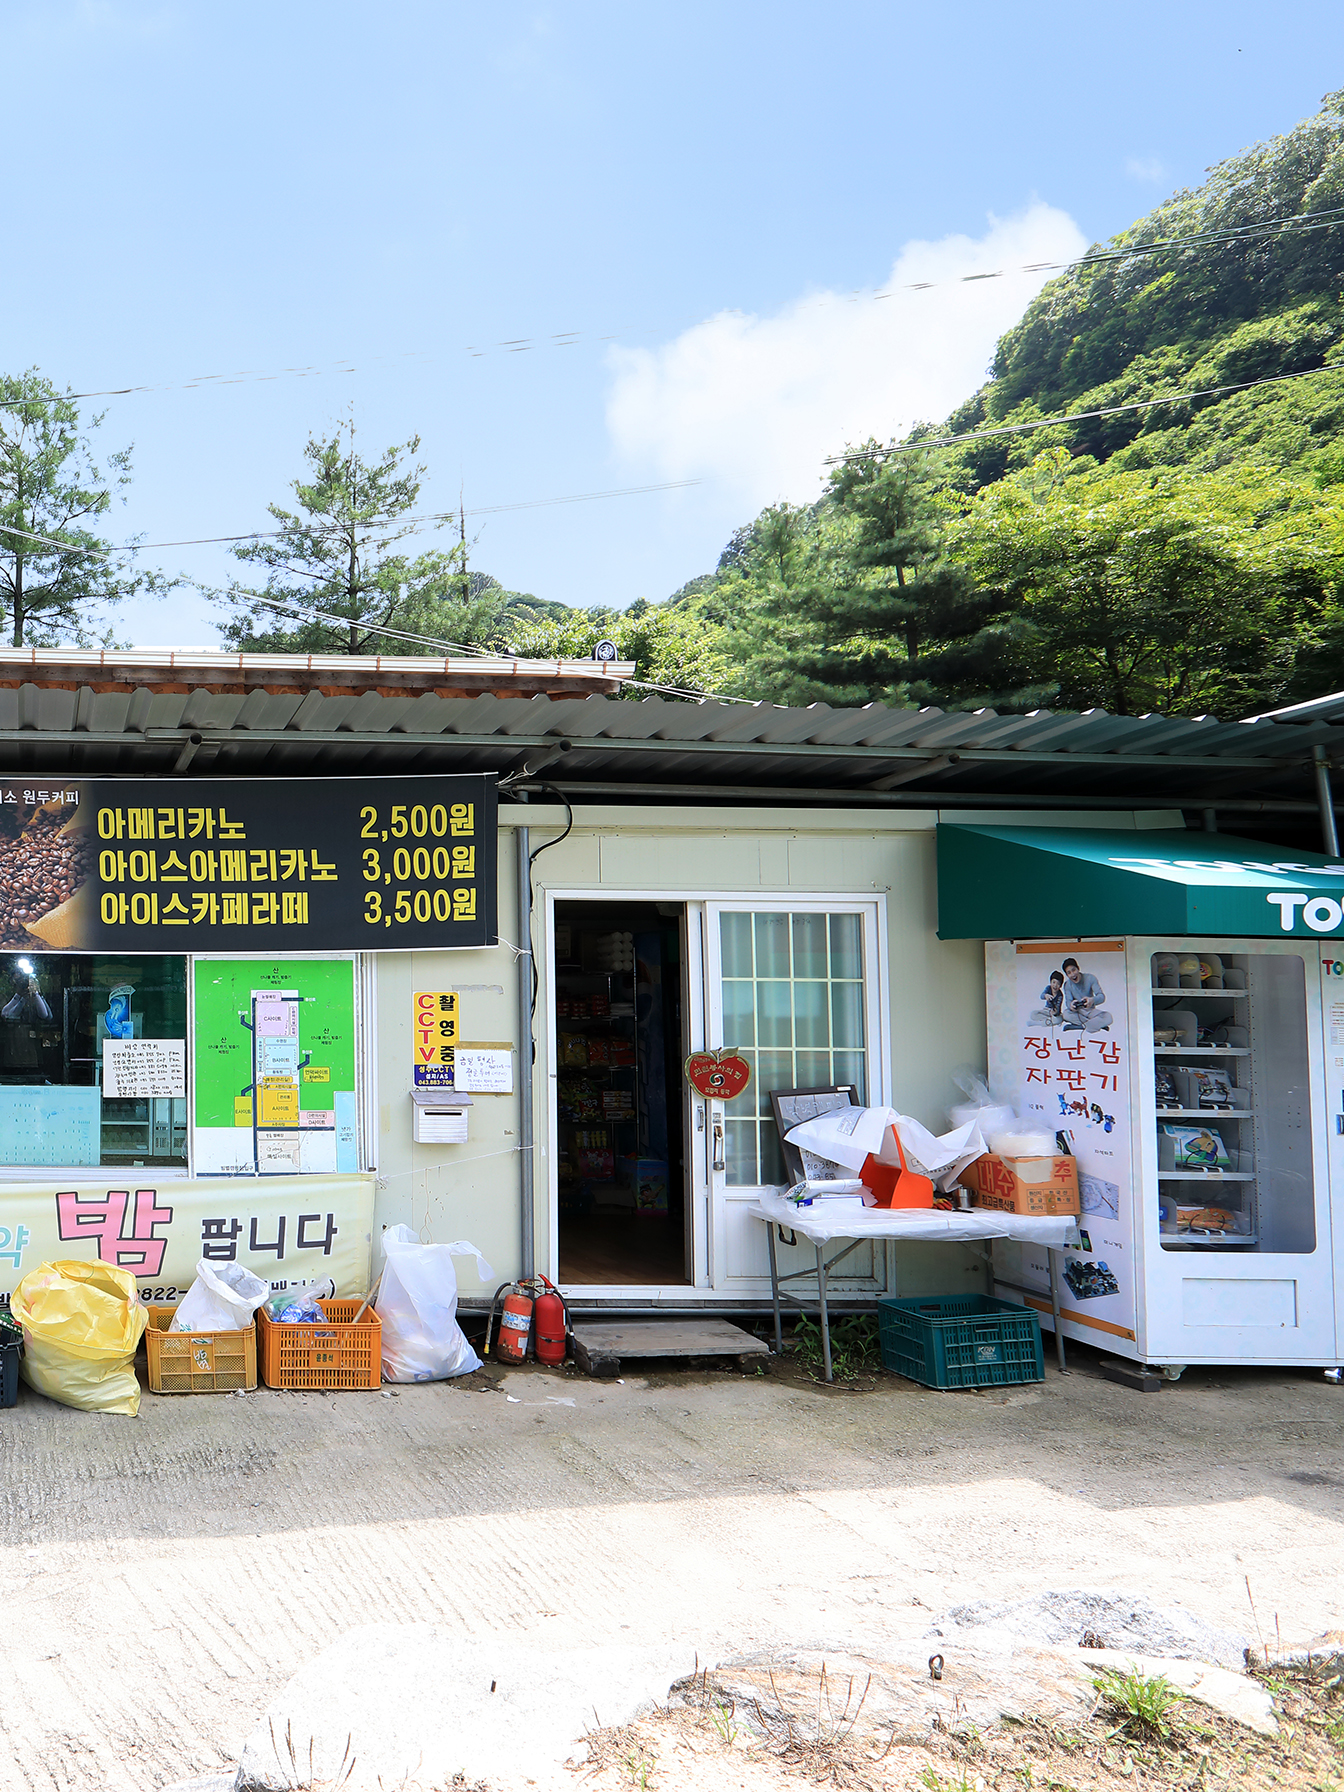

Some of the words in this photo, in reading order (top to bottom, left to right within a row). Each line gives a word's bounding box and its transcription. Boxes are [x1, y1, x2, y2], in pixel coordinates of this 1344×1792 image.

[22, 790, 79, 805] 원두커피
[97, 807, 247, 840] 아메리카노
[359, 803, 475, 842] 2,500원
[98, 849, 339, 882] 아이스아메리카노
[362, 845, 476, 885] 3,000원
[100, 892, 309, 925] 아이스카페라떼
[364, 887, 477, 928] 3,500원
[1266, 892, 1344, 932] TO
[418, 994, 436, 1062] CCTV
[439, 995, 455, 1062] 촬영중
[1024, 1037, 1122, 1064] 장난감
[1026, 1067, 1117, 1091] 자판기
[56, 1189, 174, 1278] 밤
[201, 1213, 338, 1261] 팝니다
